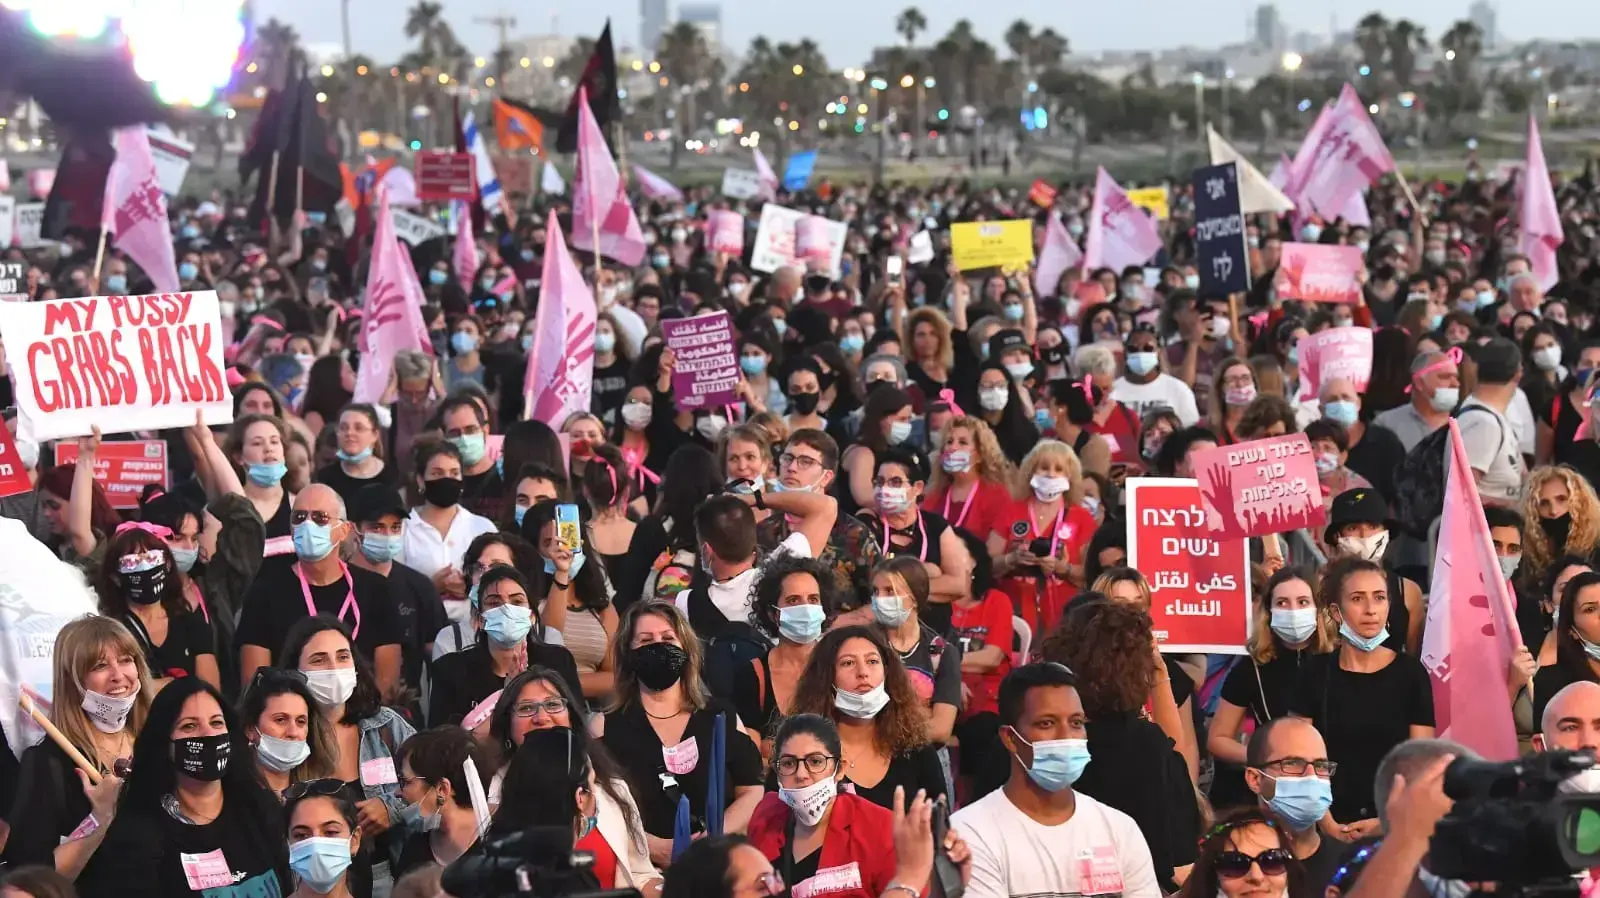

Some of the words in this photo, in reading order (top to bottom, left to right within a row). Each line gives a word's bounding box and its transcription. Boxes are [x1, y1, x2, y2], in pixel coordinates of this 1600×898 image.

[44, 299, 98, 336] MY
[108, 293, 193, 328] PUSSY
[27, 328, 138, 413] GRABS
[138, 322, 225, 408] BACK
[1227, 447, 1268, 468] נשים
[1269, 439, 1311, 459] ביחד
[1256, 462, 1286, 482] סוף
[1240, 476, 1308, 504] לאלימות
[1142, 503, 1205, 527] לרצח
[1162, 536, 1220, 557] נשים
[1149, 571, 1189, 593] لقتل
[1195, 571, 1237, 594] كفى
[1165, 599, 1221, 617] النساء
